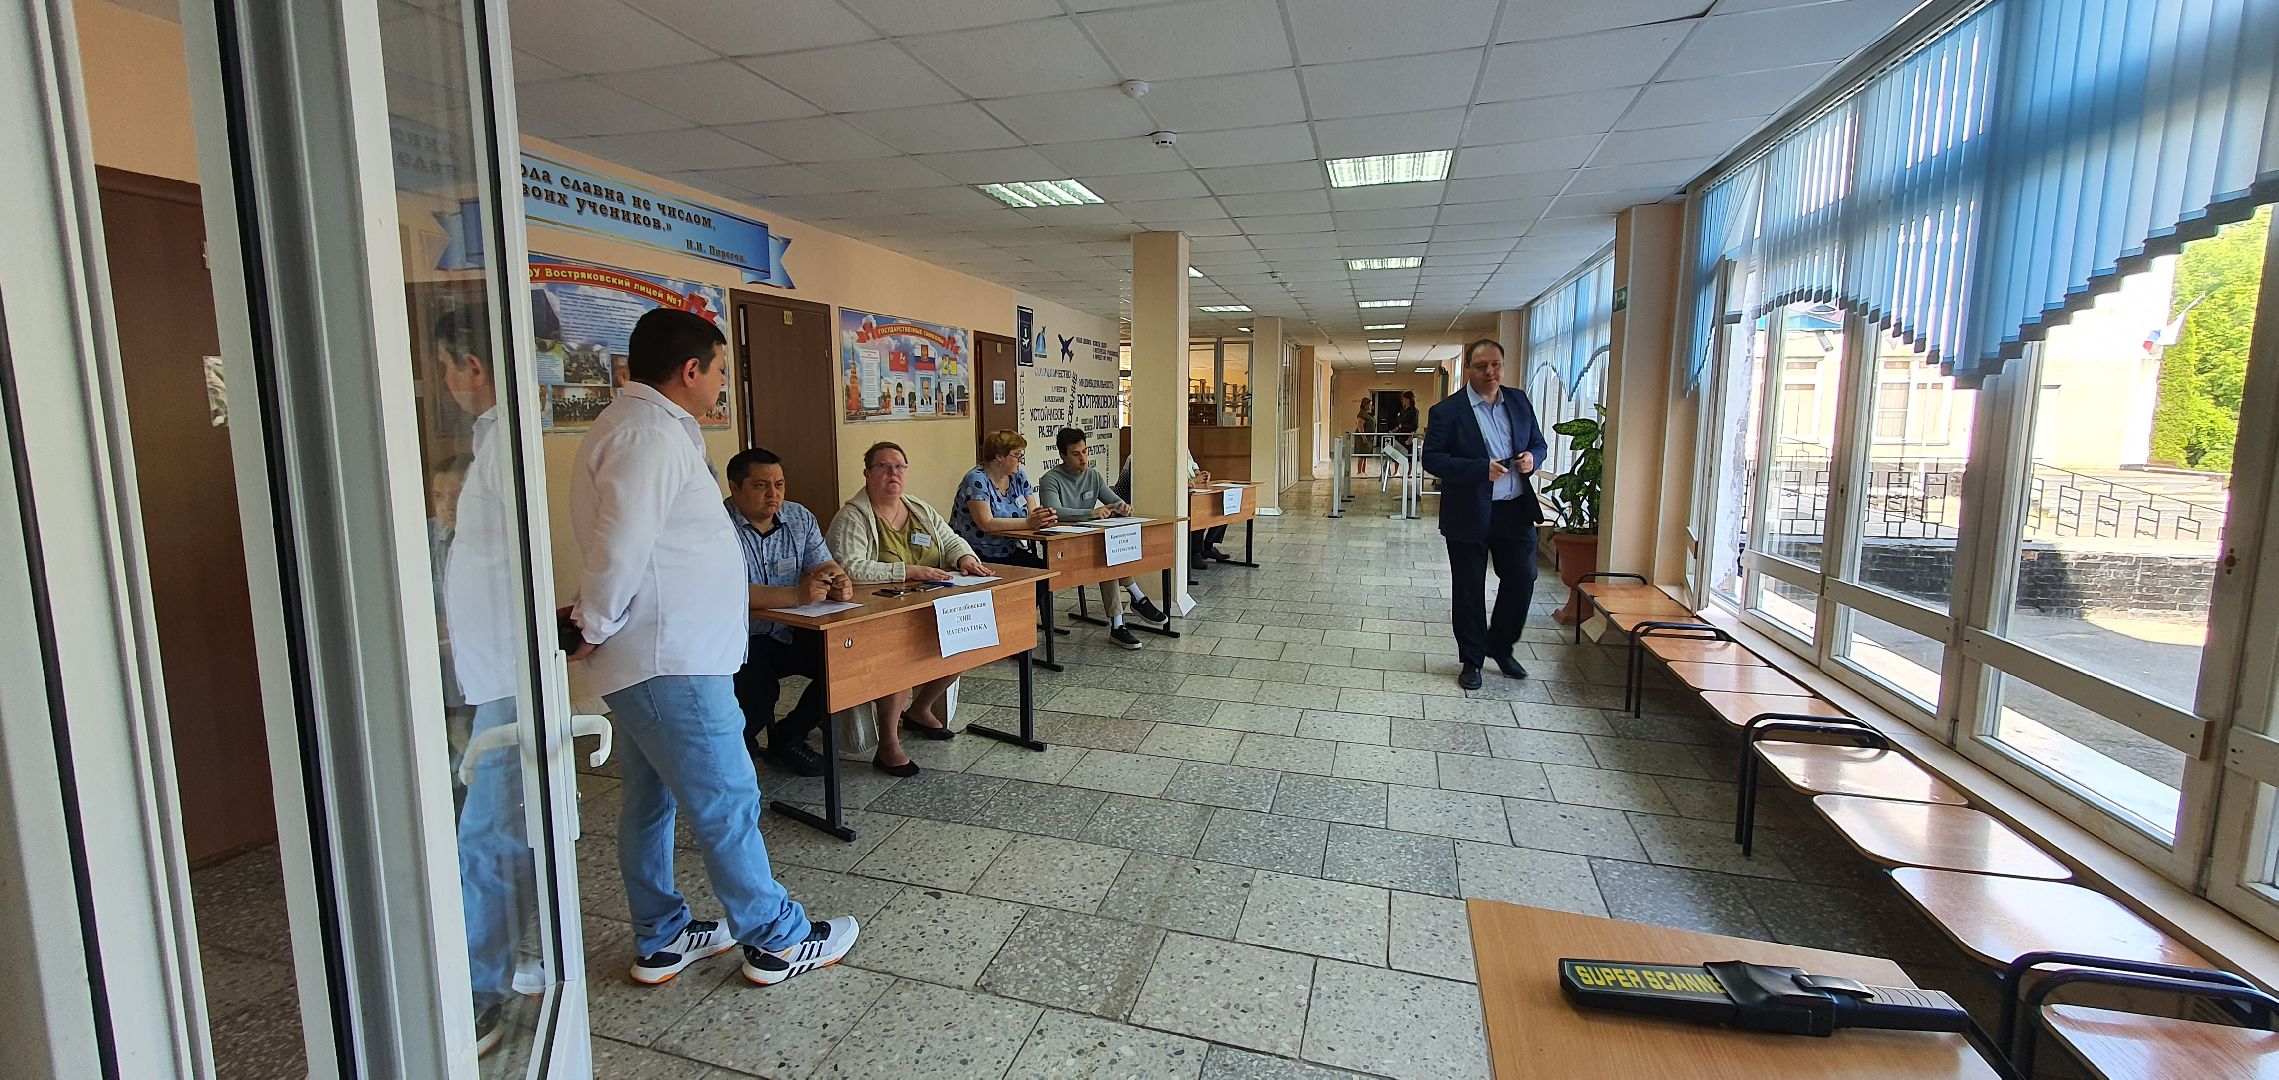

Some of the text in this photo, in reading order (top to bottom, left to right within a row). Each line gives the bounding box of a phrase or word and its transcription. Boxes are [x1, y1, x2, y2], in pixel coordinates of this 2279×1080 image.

[522, 182, 569, 208] воих
[560, 175, 626, 205] славна
[632, 195, 651, 211] не
[657, 202, 716, 231] числом,
[545, 267, 631, 288] Востряковский
[634, 283, 664, 299] лицей
[667, 293, 683, 307] №1
[946, 623, 988, 636] МАТЕМАТИКА
[1574, 965, 1727, 995] SUPER SCANNE
